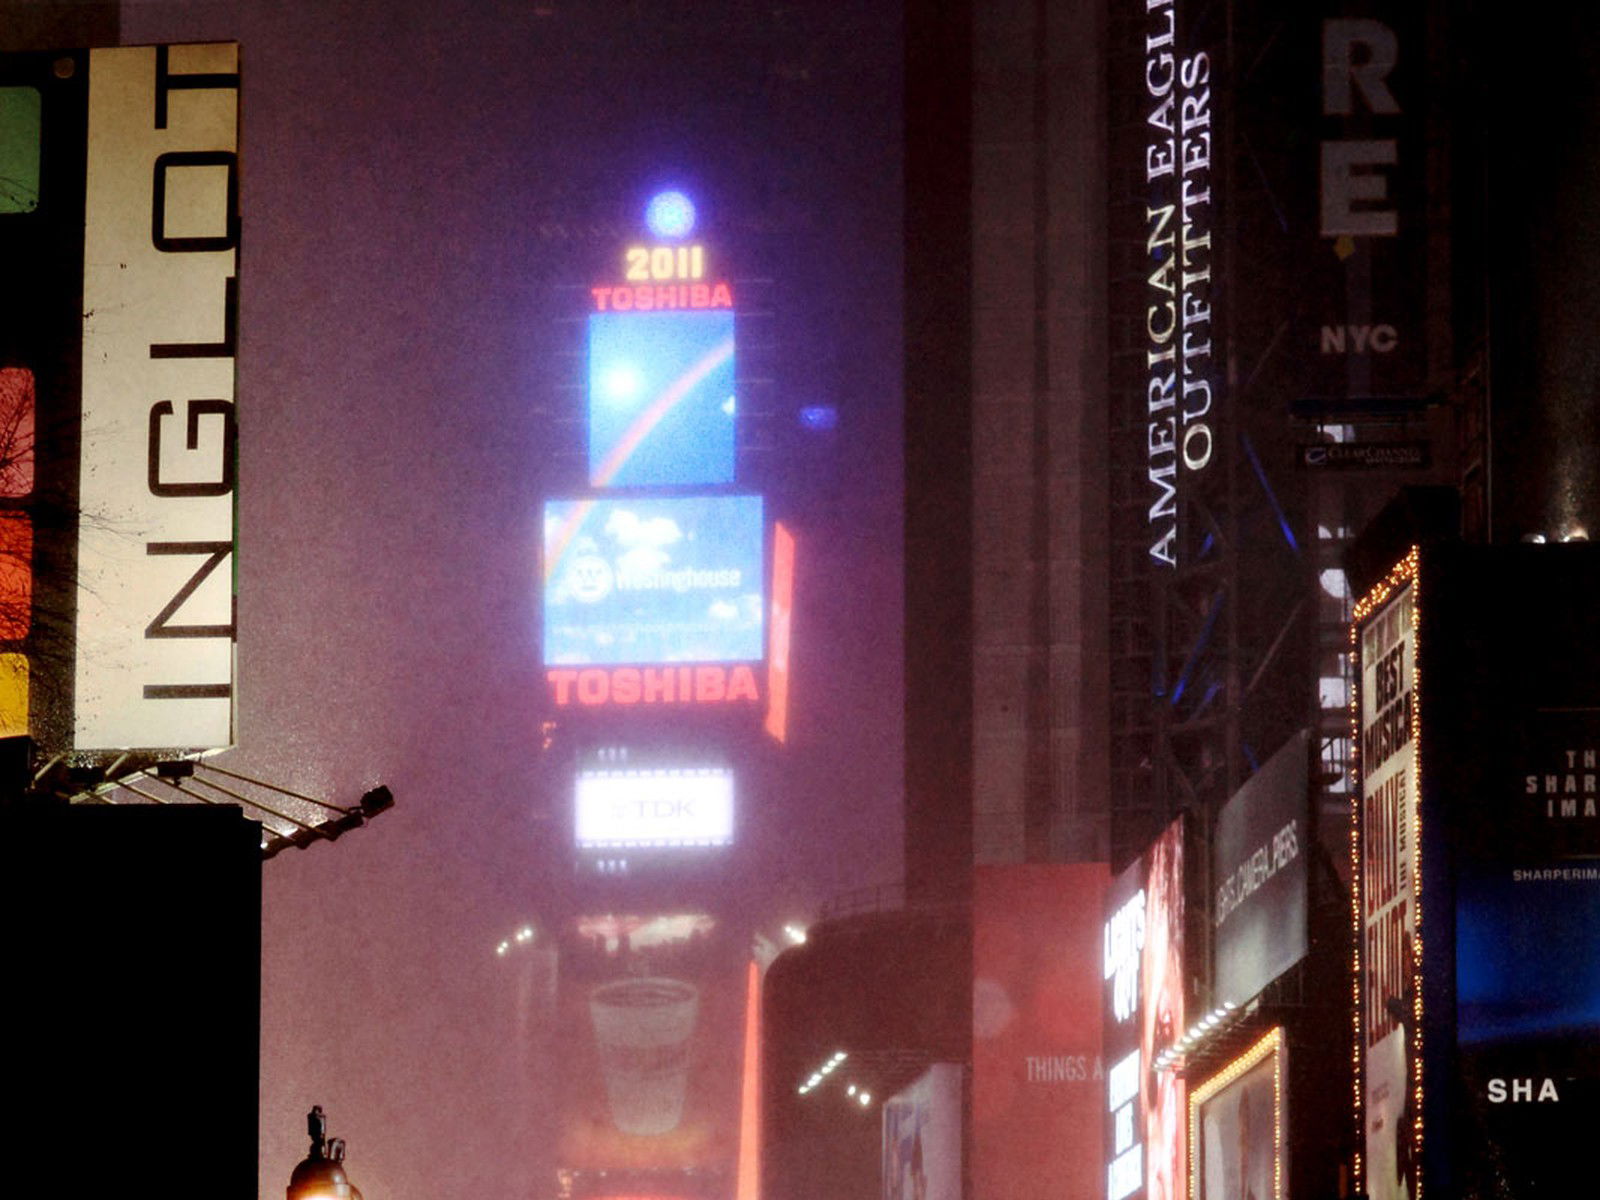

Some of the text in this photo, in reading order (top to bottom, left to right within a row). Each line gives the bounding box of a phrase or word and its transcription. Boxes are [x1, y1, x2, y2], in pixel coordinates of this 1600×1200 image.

[626, 246, 703, 280] 2011
[1182, 51, 1212, 470] OUTFITTERS
[592, 282, 733, 311] TOSHIBA
[1320, 325, 1398, 354] NYC
[142, 44, 240, 699] INGLOT
[1147, 204, 1177, 569] AMERICAN
[547, 666, 759, 706] TOSHIBA
[1376, 640, 1405, 714] BEST
[1364, 690, 1412, 779] MUSICA
[1566, 750, 1597, 768] TH
[1525, 775, 1597, 794] SHAR
[633, 801, 695, 818] TDK
[1547, 799, 1597, 818] IMA
[1027, 1056, 1087, 1081] THINGS
[1488, 1078, 1559, 1103] SHA
